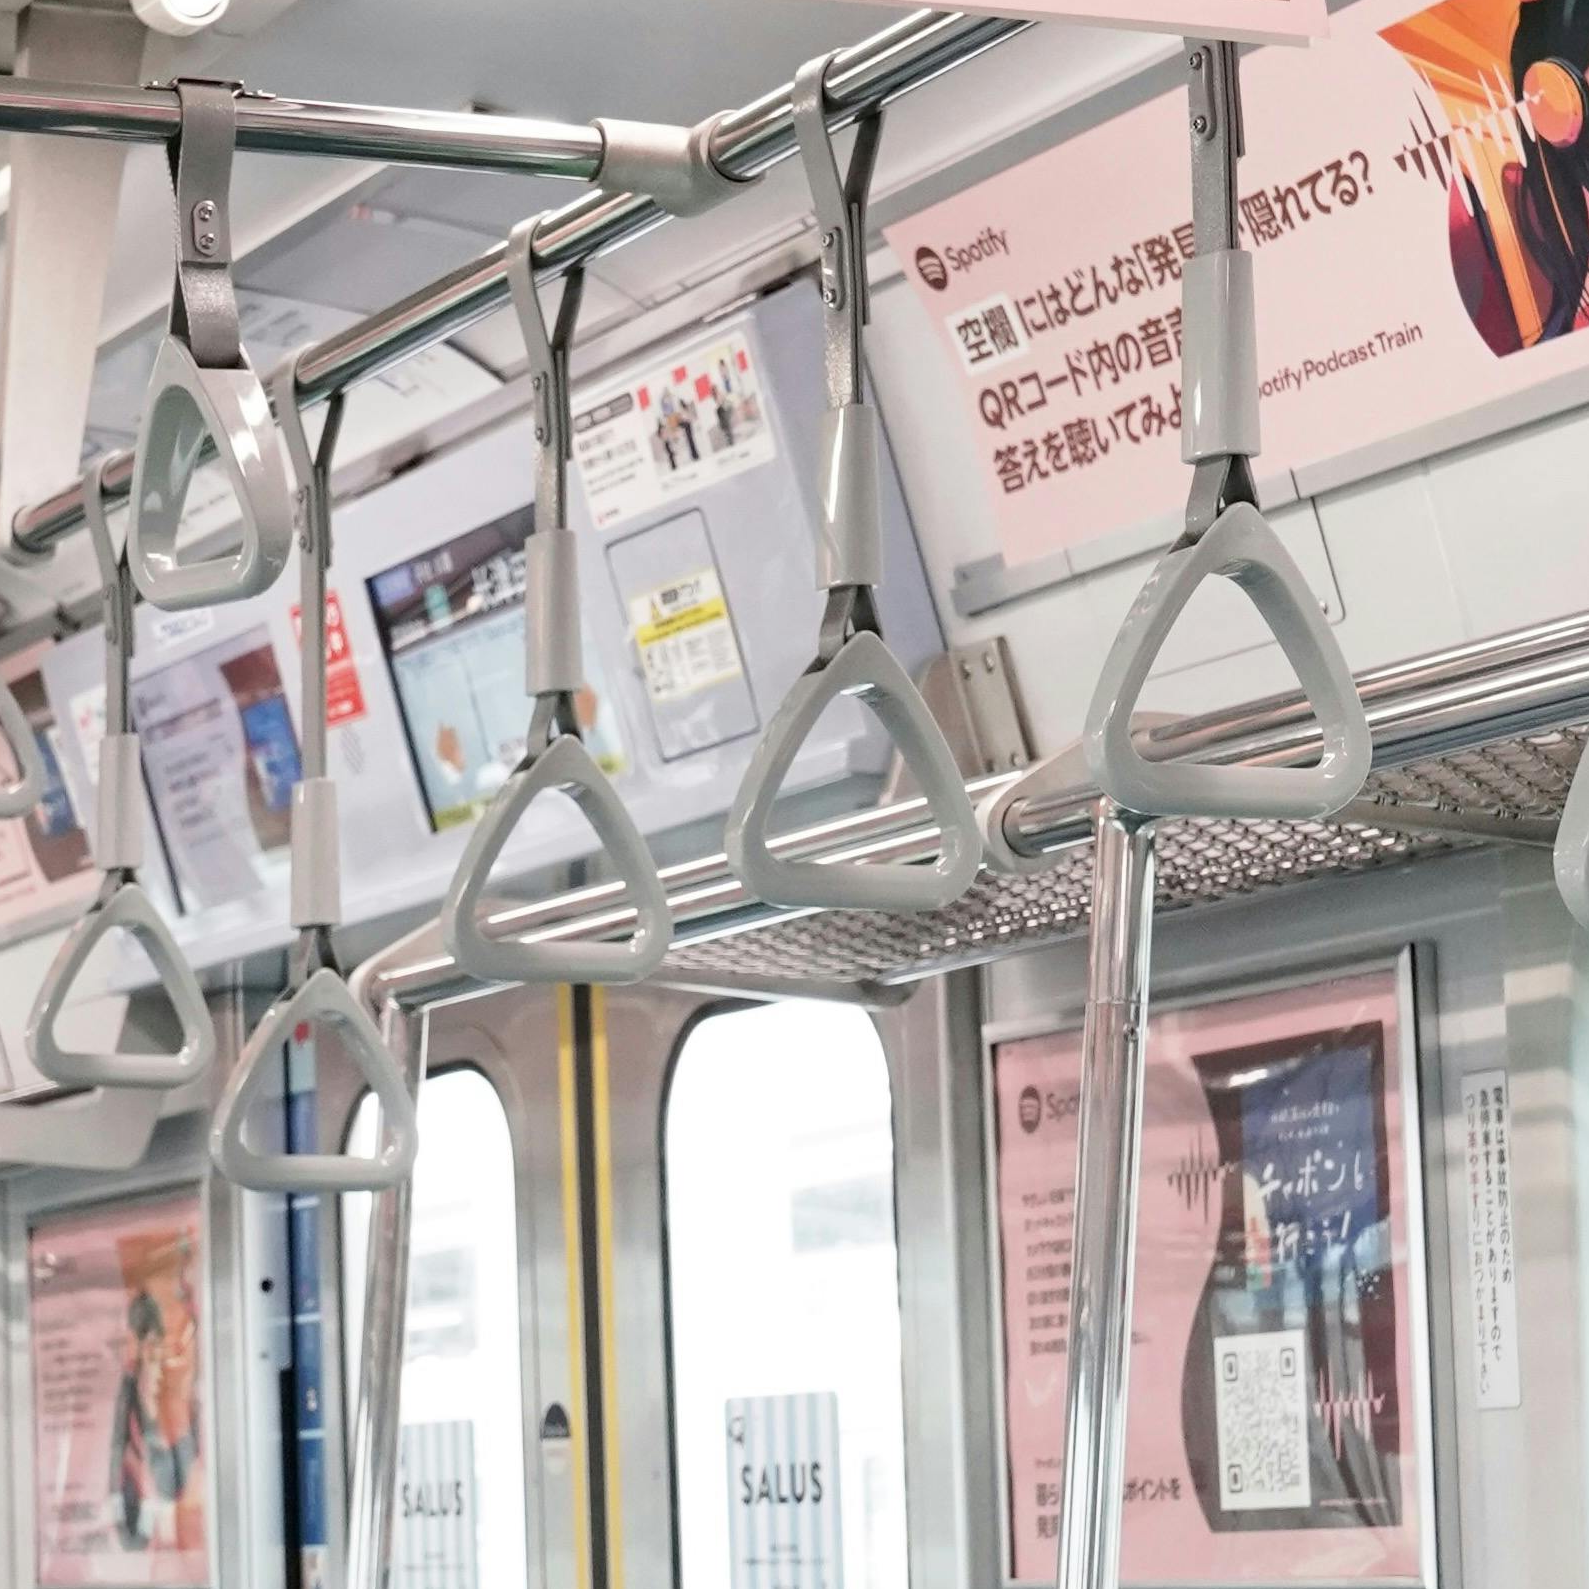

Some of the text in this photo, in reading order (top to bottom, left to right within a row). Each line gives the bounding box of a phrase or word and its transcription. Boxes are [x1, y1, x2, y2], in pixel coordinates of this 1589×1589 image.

[944, 226, 1011, 273] Spotify
[1302, 339, 1376, 383] Podcast
[1374, 321, 1424, 355] Train
[741, 1460, 823, 1505] SALUS
